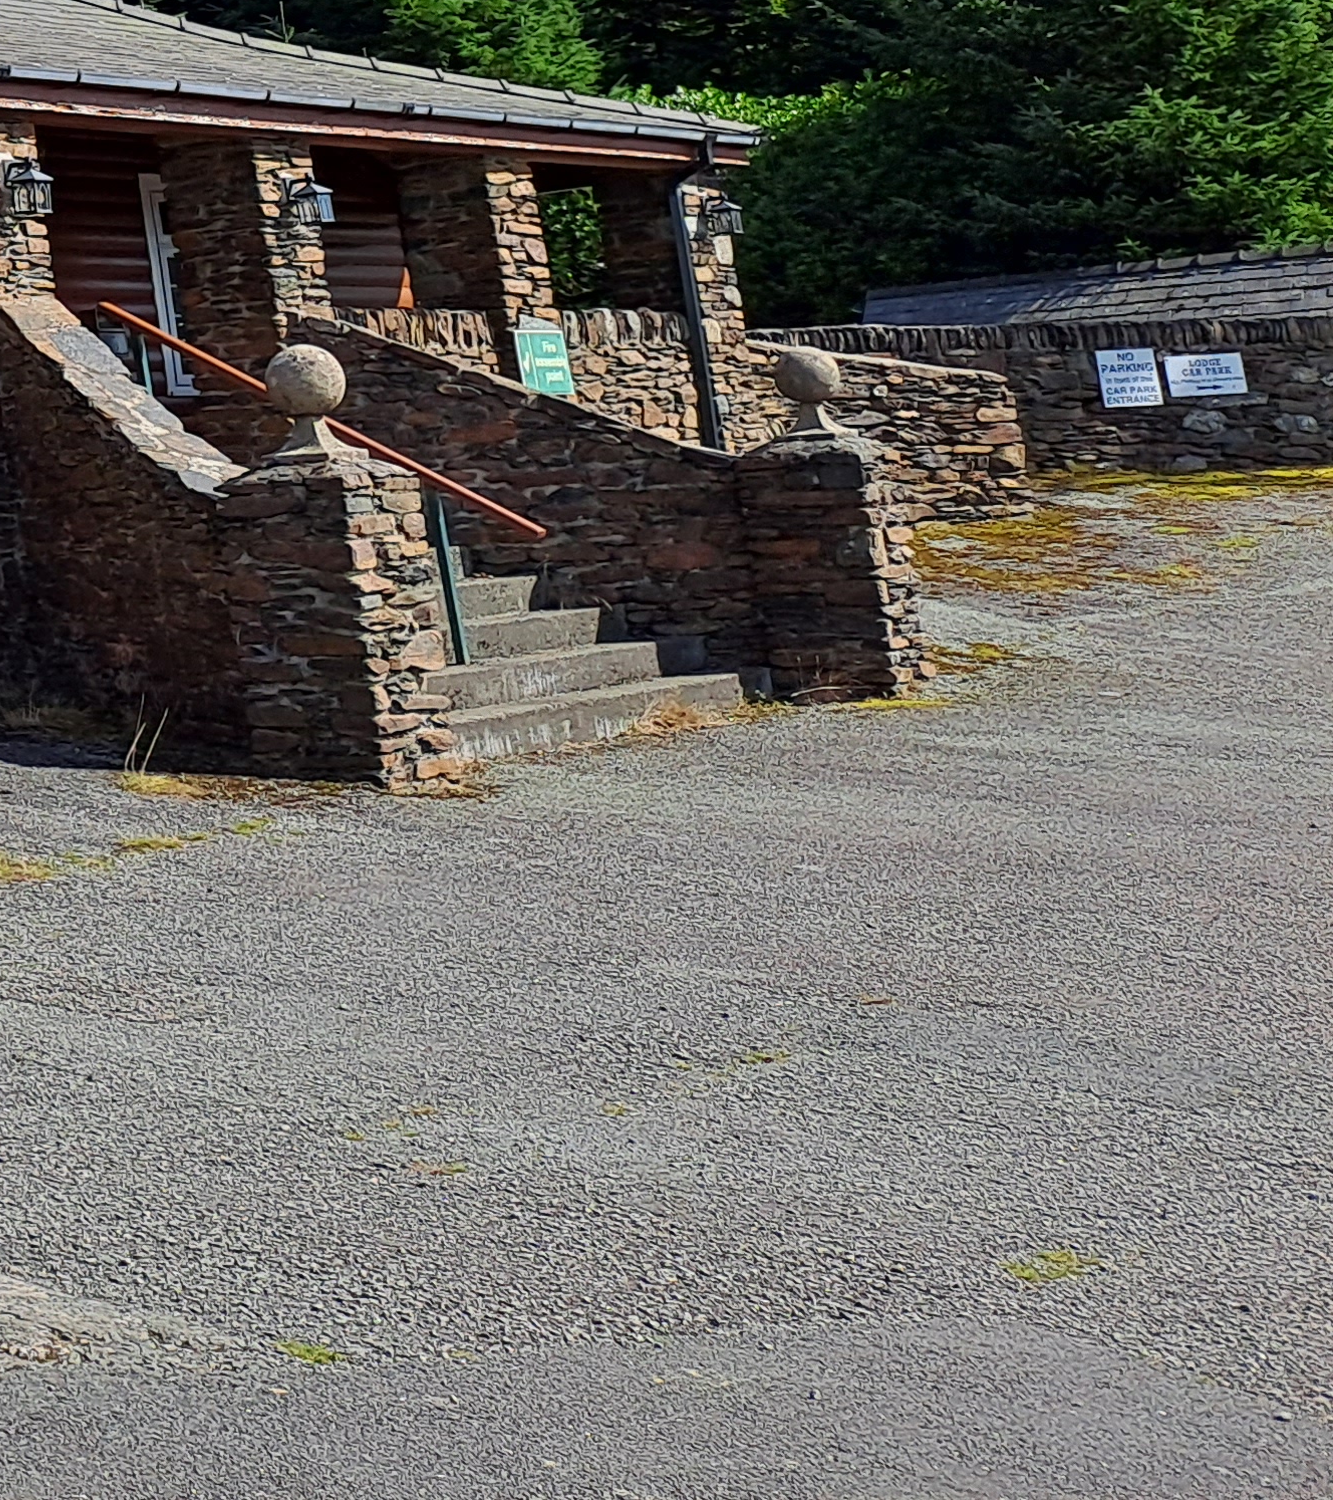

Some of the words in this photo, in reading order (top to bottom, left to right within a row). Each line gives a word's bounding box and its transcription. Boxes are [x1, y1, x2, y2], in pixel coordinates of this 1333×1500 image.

[1116, 352, 1134, 362] NO
[1188, 358, 1221, 367] LODGE
[1101, 363, 1154, 373] PARKING
[1181, 368, 1202, 377] CAR
[1205, 366, 1232, 376] PARK
[1106, 386, 1128, 396] CAR
[1129, 385, 1158, 395] PARK
[1106, 394, 1161, 405] ENTRANCE
